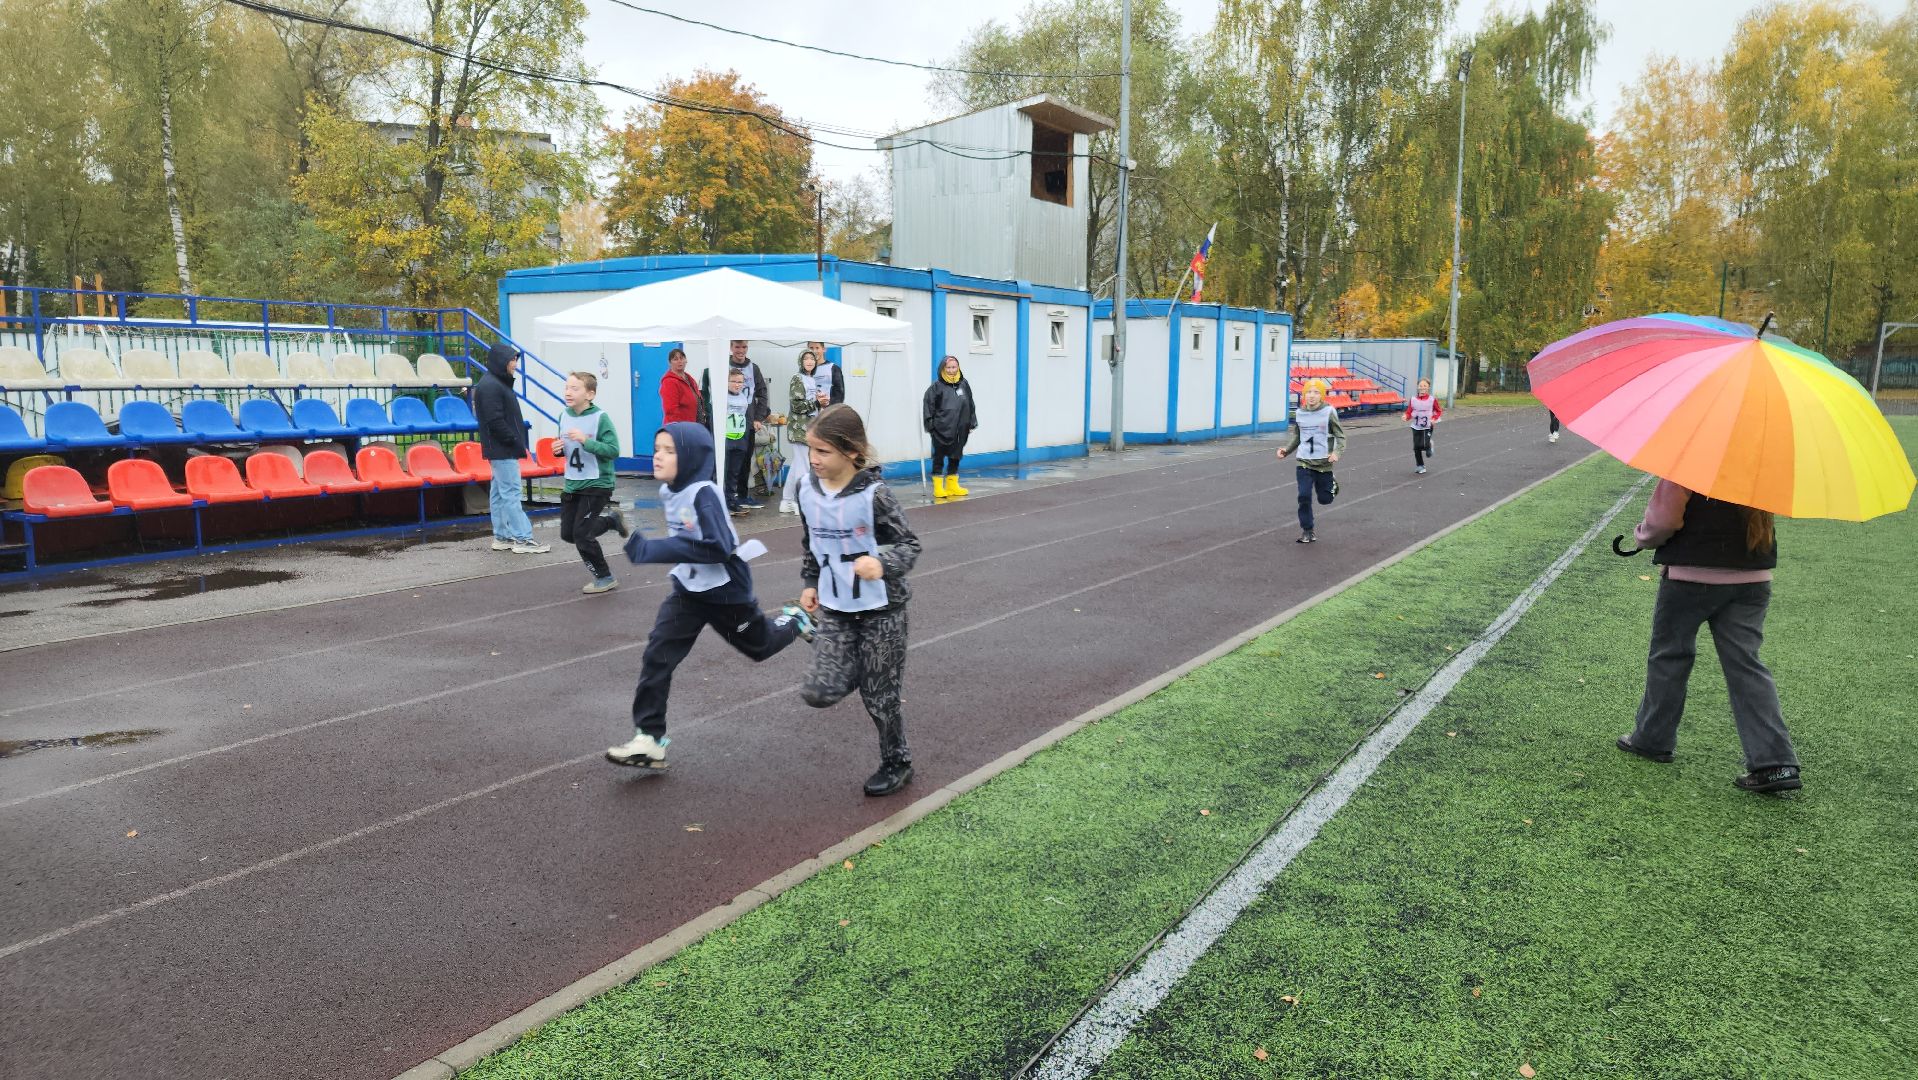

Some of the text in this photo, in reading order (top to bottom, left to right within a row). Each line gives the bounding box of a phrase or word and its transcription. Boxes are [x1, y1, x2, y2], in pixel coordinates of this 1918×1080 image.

[728, 413, 745, 428] 12
[1415, 415, 1428, 428] 13
[1305, 436, 1314, 454] 1
[569, 448, 585, 473] 4
